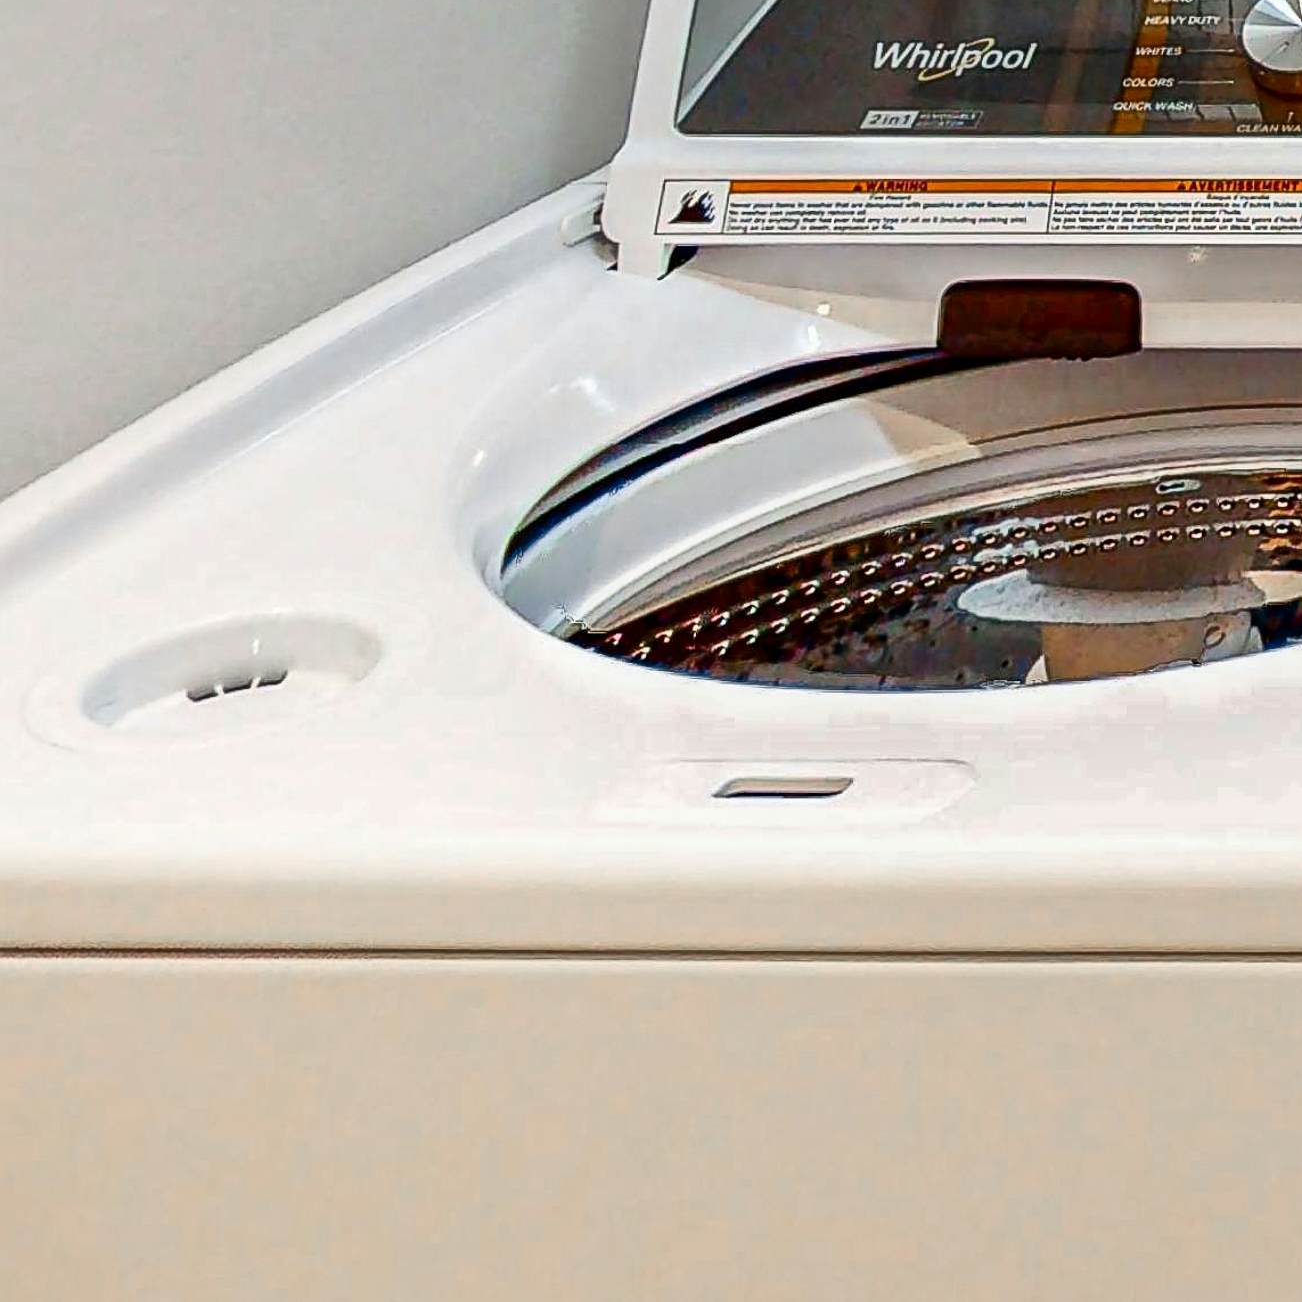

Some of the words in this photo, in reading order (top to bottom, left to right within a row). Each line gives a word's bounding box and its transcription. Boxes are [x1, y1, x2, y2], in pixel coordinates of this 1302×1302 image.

[1144, 16, 1185, 26] HEAVY
[1187, 15, 1221, 25] DUTY
[1135, 47, 1182, 56] WHITES
[873, 40, 1038, 79] Whirlpool
[1122, 77, 1175, 88] COLORS
[1113, 101, 1153, 112] QUICK
[1155, 101, 1195, 111] WASH
[1237, 124, 1280, 133] CLEAN
[866, 180, 928, 192] WARNING
[1188, 180, 1300, 192] AVERTISSEMENT
